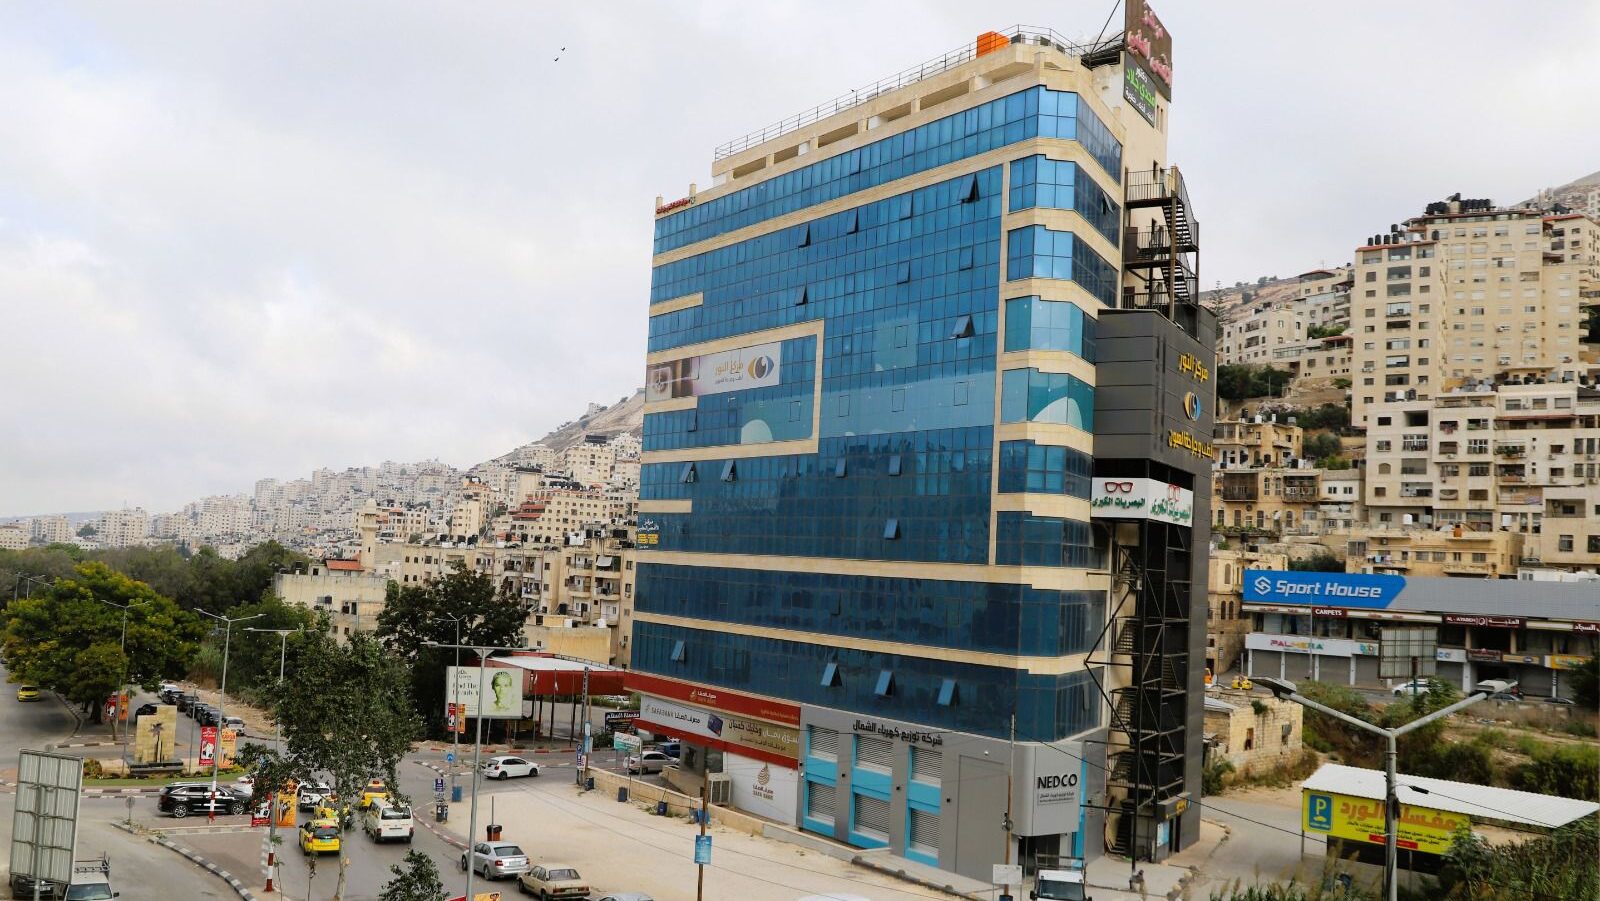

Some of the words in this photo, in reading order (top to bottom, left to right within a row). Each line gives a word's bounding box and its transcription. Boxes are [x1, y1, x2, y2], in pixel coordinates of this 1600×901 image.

[1178, 352, 1193, 375] النور
[1192, 358, 1209, 382] مركز
[1091, 496, 1114, 509] الكبرى
[1114, 497, 1146, 510] البصريات
[1275, 580, 1321, 597] Sport
[1325, 582, 1382, 598] House
[1314, 608, 1343, 616] CARPETS
[674, 711, 687, 722] الصفا
[687, 715, 701, 725] مصرف
[852, 719, 877, 733] الشمال
[877, 724, 900, 739] كهرباء
[900, 730, 920, 744] توزيع
[1037, 773, 1078, 789] NEDCO
[1316, 798, 1327, 815] P
[1341, 801, 1384, 820] الورد
[1399, 808, 1458, 830] مغسل
